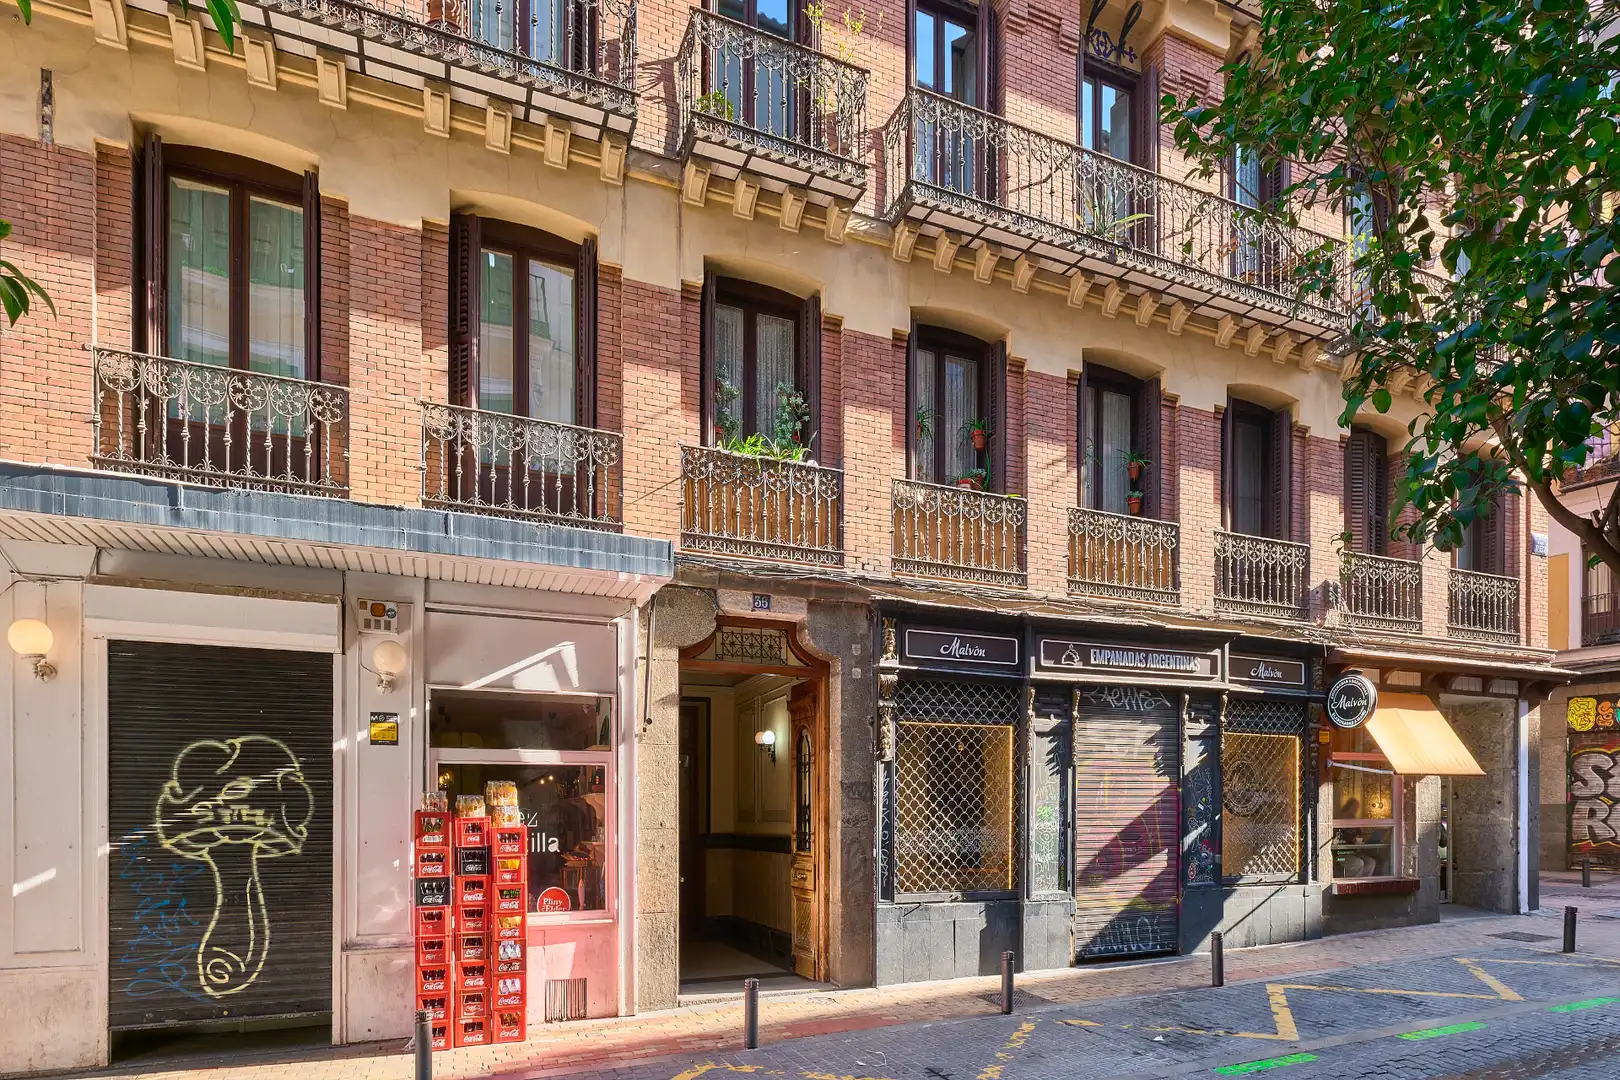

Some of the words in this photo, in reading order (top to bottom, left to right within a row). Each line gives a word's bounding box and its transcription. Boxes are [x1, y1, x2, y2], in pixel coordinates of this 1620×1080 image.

[940, 636, 986, 658] Malvón
[1090, 648, 1146, 669] EMPANADAS
[1146, 653, 1201, 671] ARGENTINAS
[1250, 661, 1283, 679] Malvón
[1331, 694, 1367, 710] Malvón
[422, 894, 444, 904] Coca-Cola
[543, 897, 563, 907] Pliny
[423, 981, 444, 991] Coca-Cola
